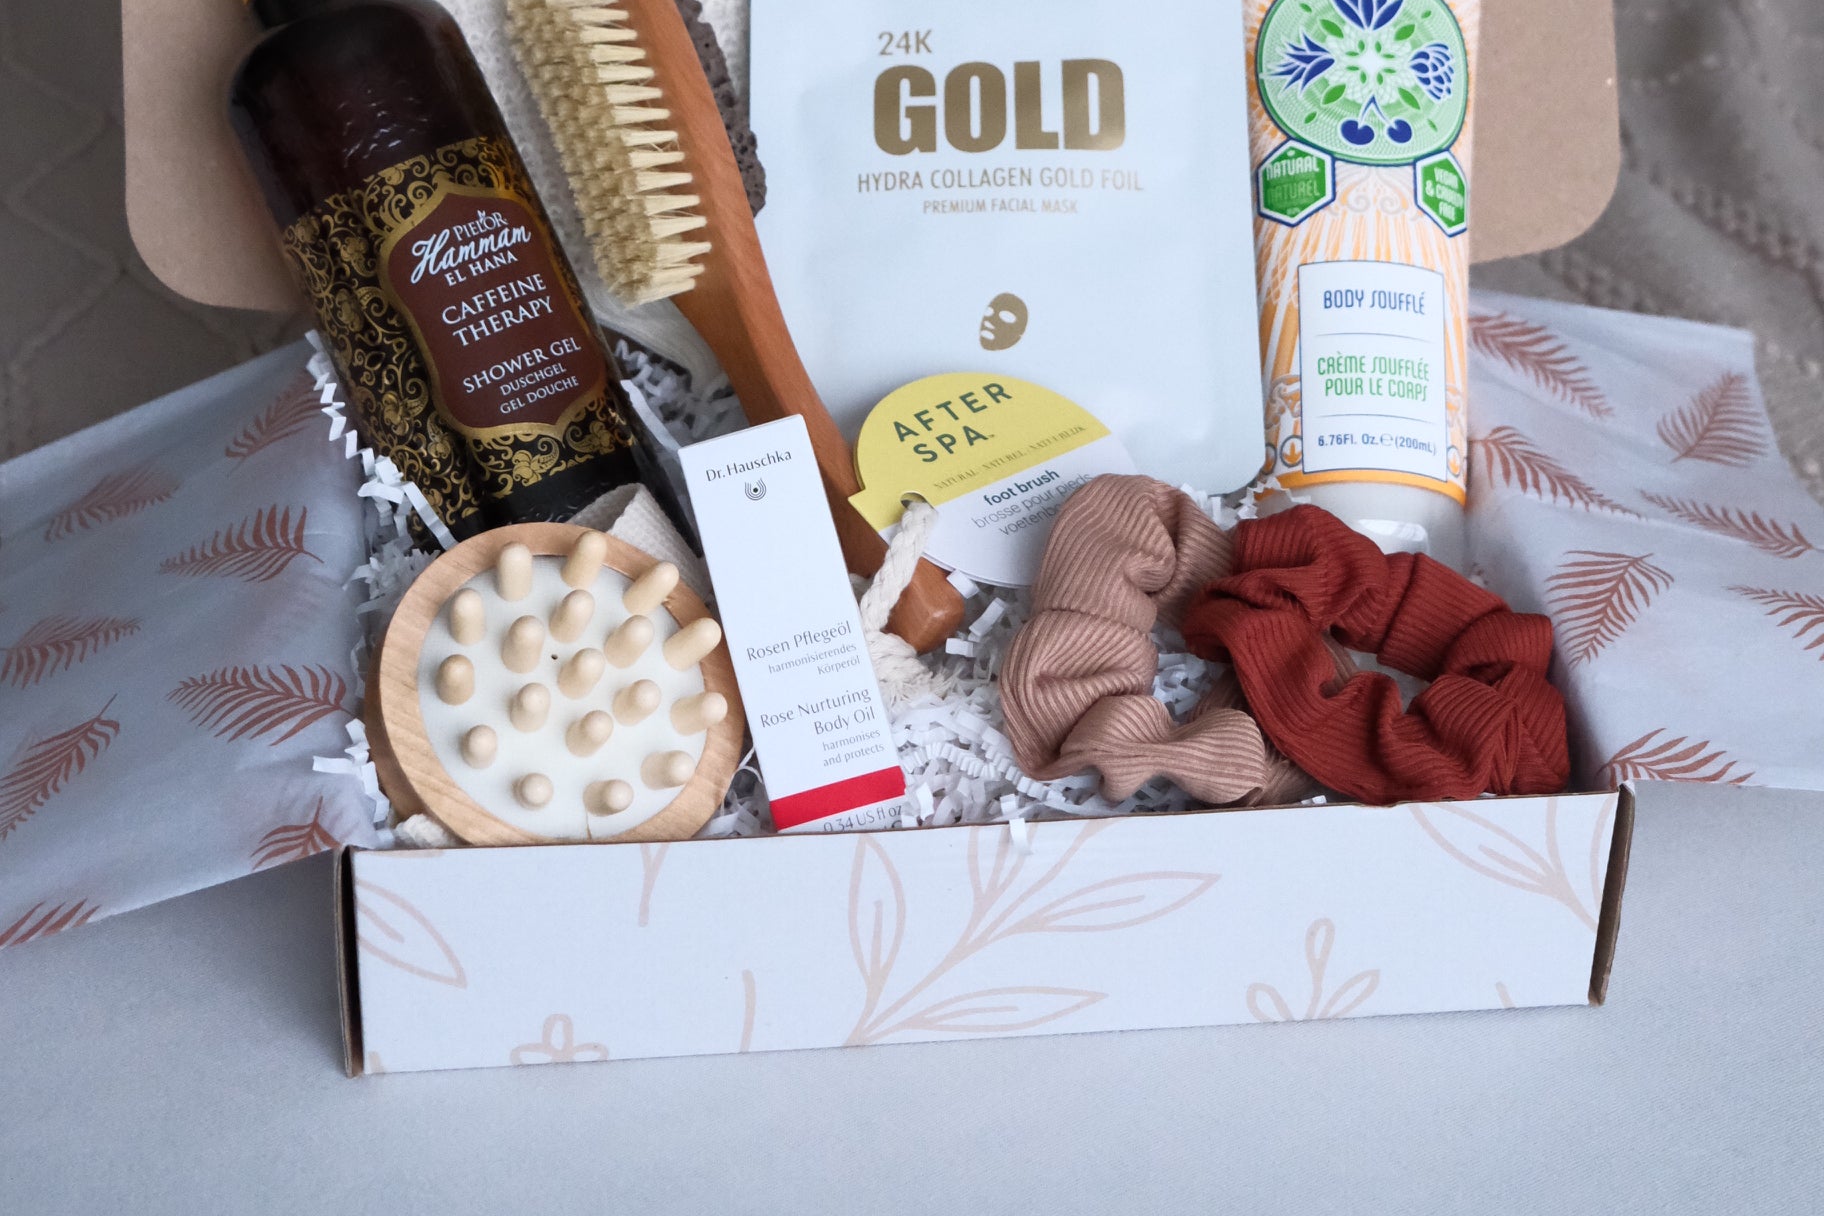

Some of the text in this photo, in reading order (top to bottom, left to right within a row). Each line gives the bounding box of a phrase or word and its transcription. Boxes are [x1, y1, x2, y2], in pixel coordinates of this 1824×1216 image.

[877, 29, 933, 56] 24K
[873, 58, 1126, 156] GOLD
[857, 166, 1145, 194] HYDRA COLLAGEN GOLD FOIL
[922, 198, 1078, 214] PREMIUM FACIAL MASK
[452, 211, 508, 241] PIELOR
[410, 225, 532, 284] Hammam
[444, 250, 519, 287] EL HANA
[442, 274, 548, 325] CAFFEINE
[1323, 289, 1426, 315] BODY SOUFFLÉ
[452, 296, 554, 347] THERAPY
[462, 337, 582, 394] SHOWER GEL
[499, 363, 567, 396] DUSCHGEL
[1317, 351, 1430, 382] CRÈME SOUFFLÉE
[499, 376, 580, 415] GEL DOUCHE
[1325, 377, 1428, 402] POUR LE CORPS
[892, 382, 1014, 443] AFTER
[970, 472, 1095, 529] brosse pour pieds
[983, 468, 1061, 506] foot brush
[746, 620, 853, 661] Rosen Pflegeöl
[768, 643, 858, 675] harmonisierendes
[817, 655, 862, 676] Körperöl
[760, 688, 872, 728] Rose Nurturing
[814, 706, 876, 736] Body Oil
[822, 729, 882, 752] harmonises
[823, 742, 886, 767] and protects
[855, 809, 876, 826] US
